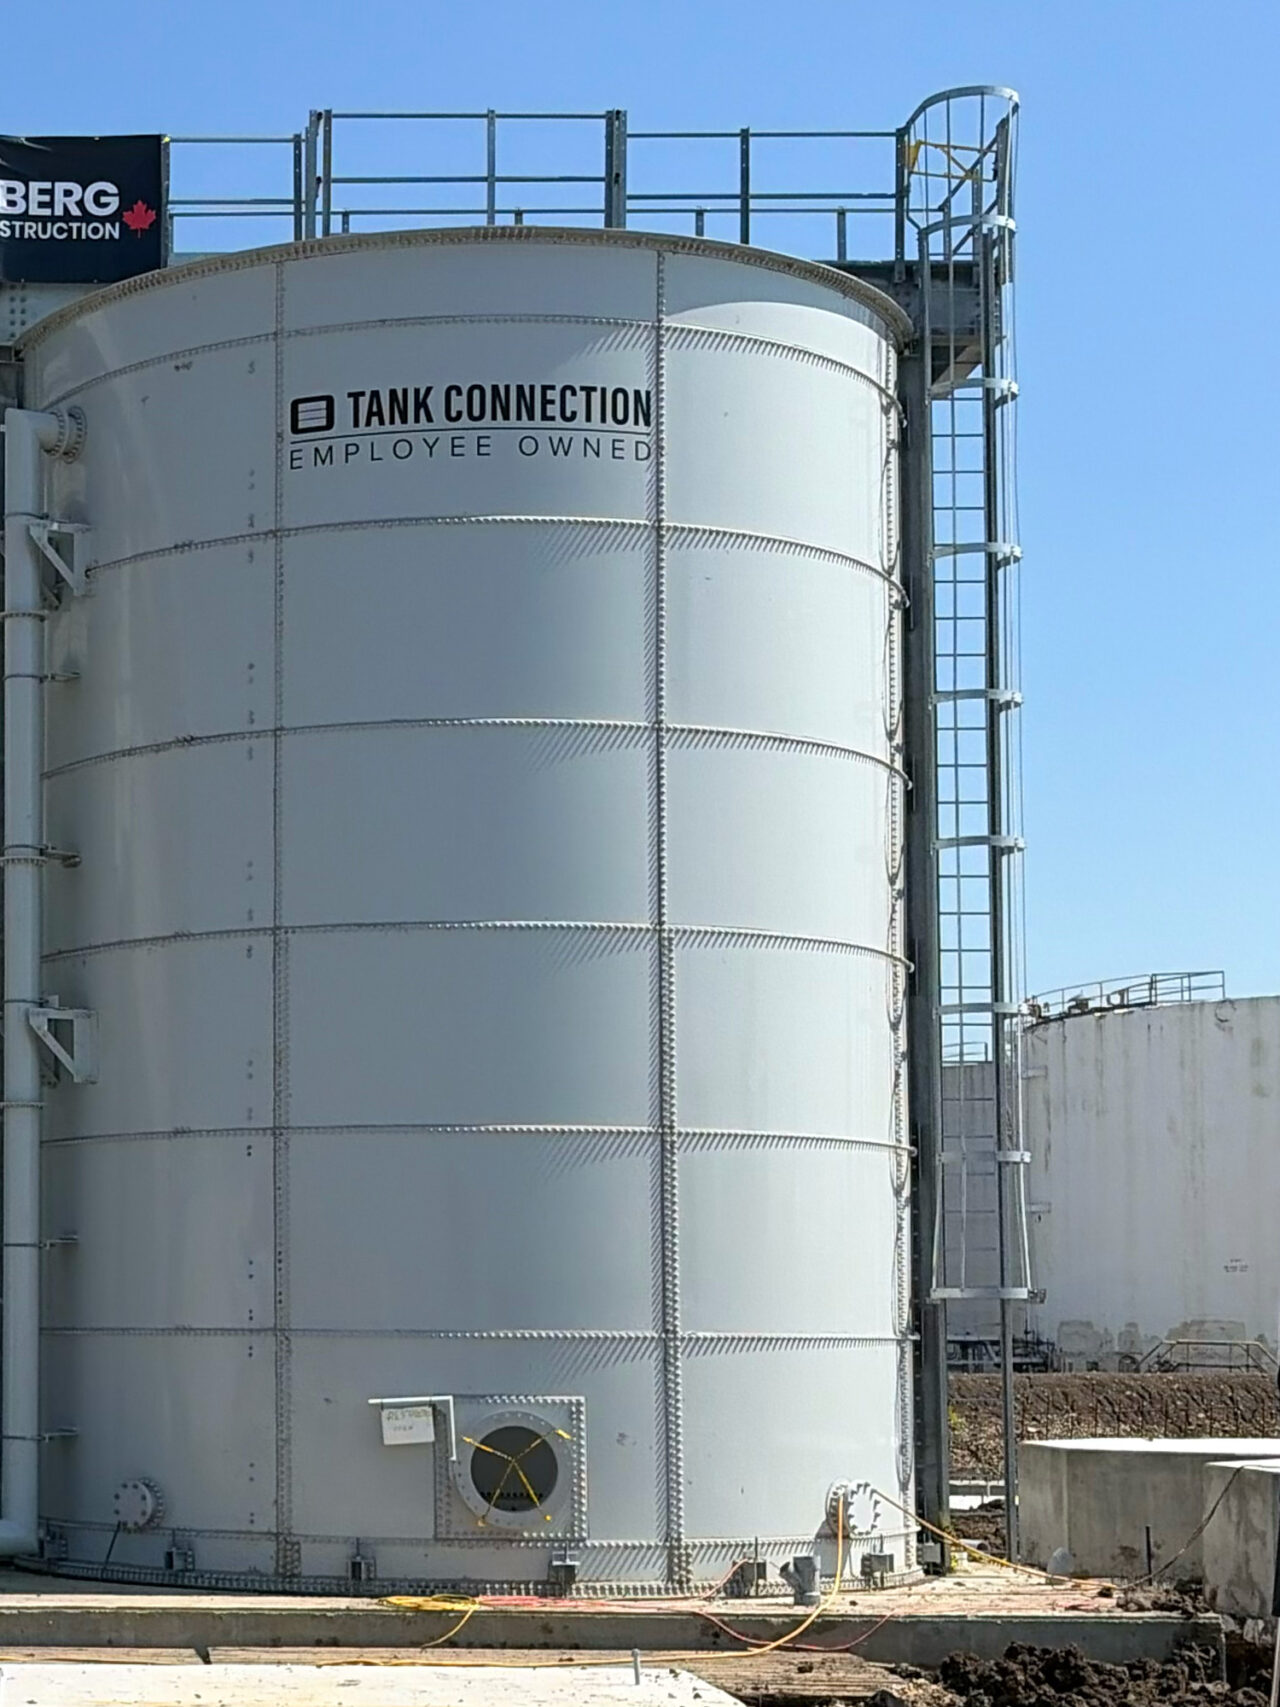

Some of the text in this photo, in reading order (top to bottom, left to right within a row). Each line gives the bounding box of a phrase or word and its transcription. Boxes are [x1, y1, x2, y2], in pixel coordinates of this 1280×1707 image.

[347, 384, 651, 428] TANK CONNECTION
[289, 435, 651, 470] EMPLOYEE OWNED
